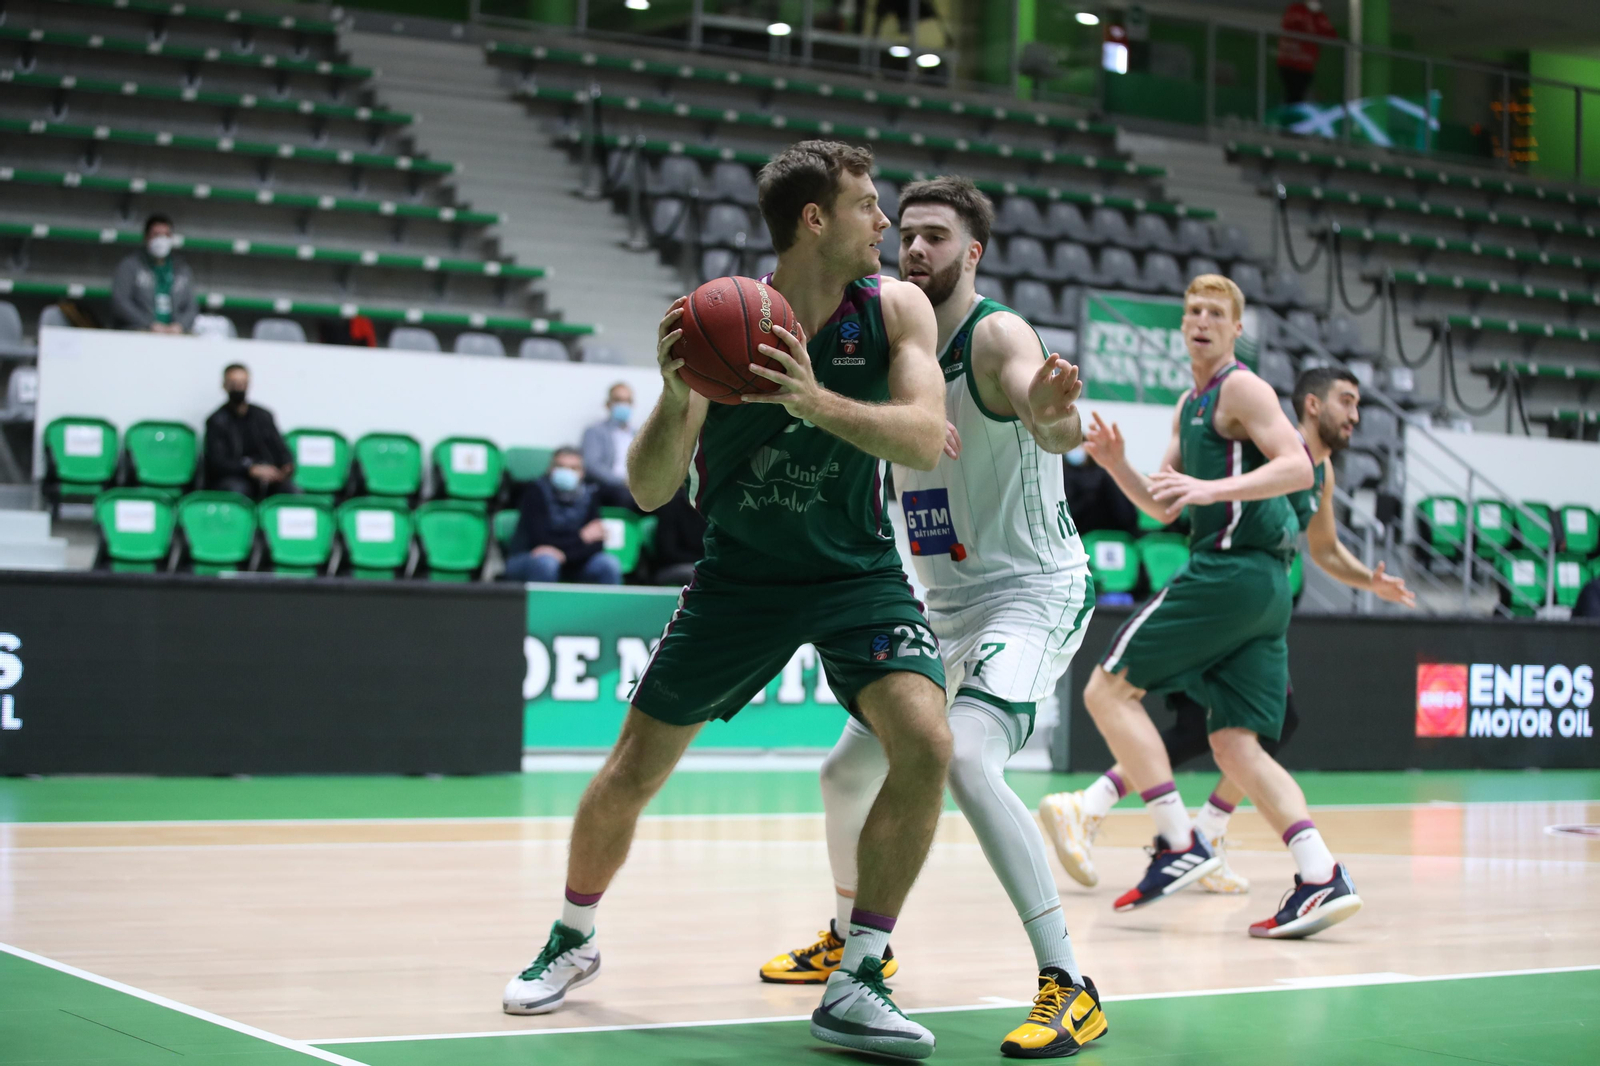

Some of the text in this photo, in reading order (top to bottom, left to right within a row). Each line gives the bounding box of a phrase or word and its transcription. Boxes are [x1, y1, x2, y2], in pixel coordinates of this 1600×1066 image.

[832, 357, 865, 365] oneteam
[907, 508, 949, 529] GTM
[894, 624, 939, 660] 23
[972, 643, 1006, 676] 7
[1470, 664, 1594, 708] ENEOS
[1469, 708, 1593, 738] MOTOR OIL
